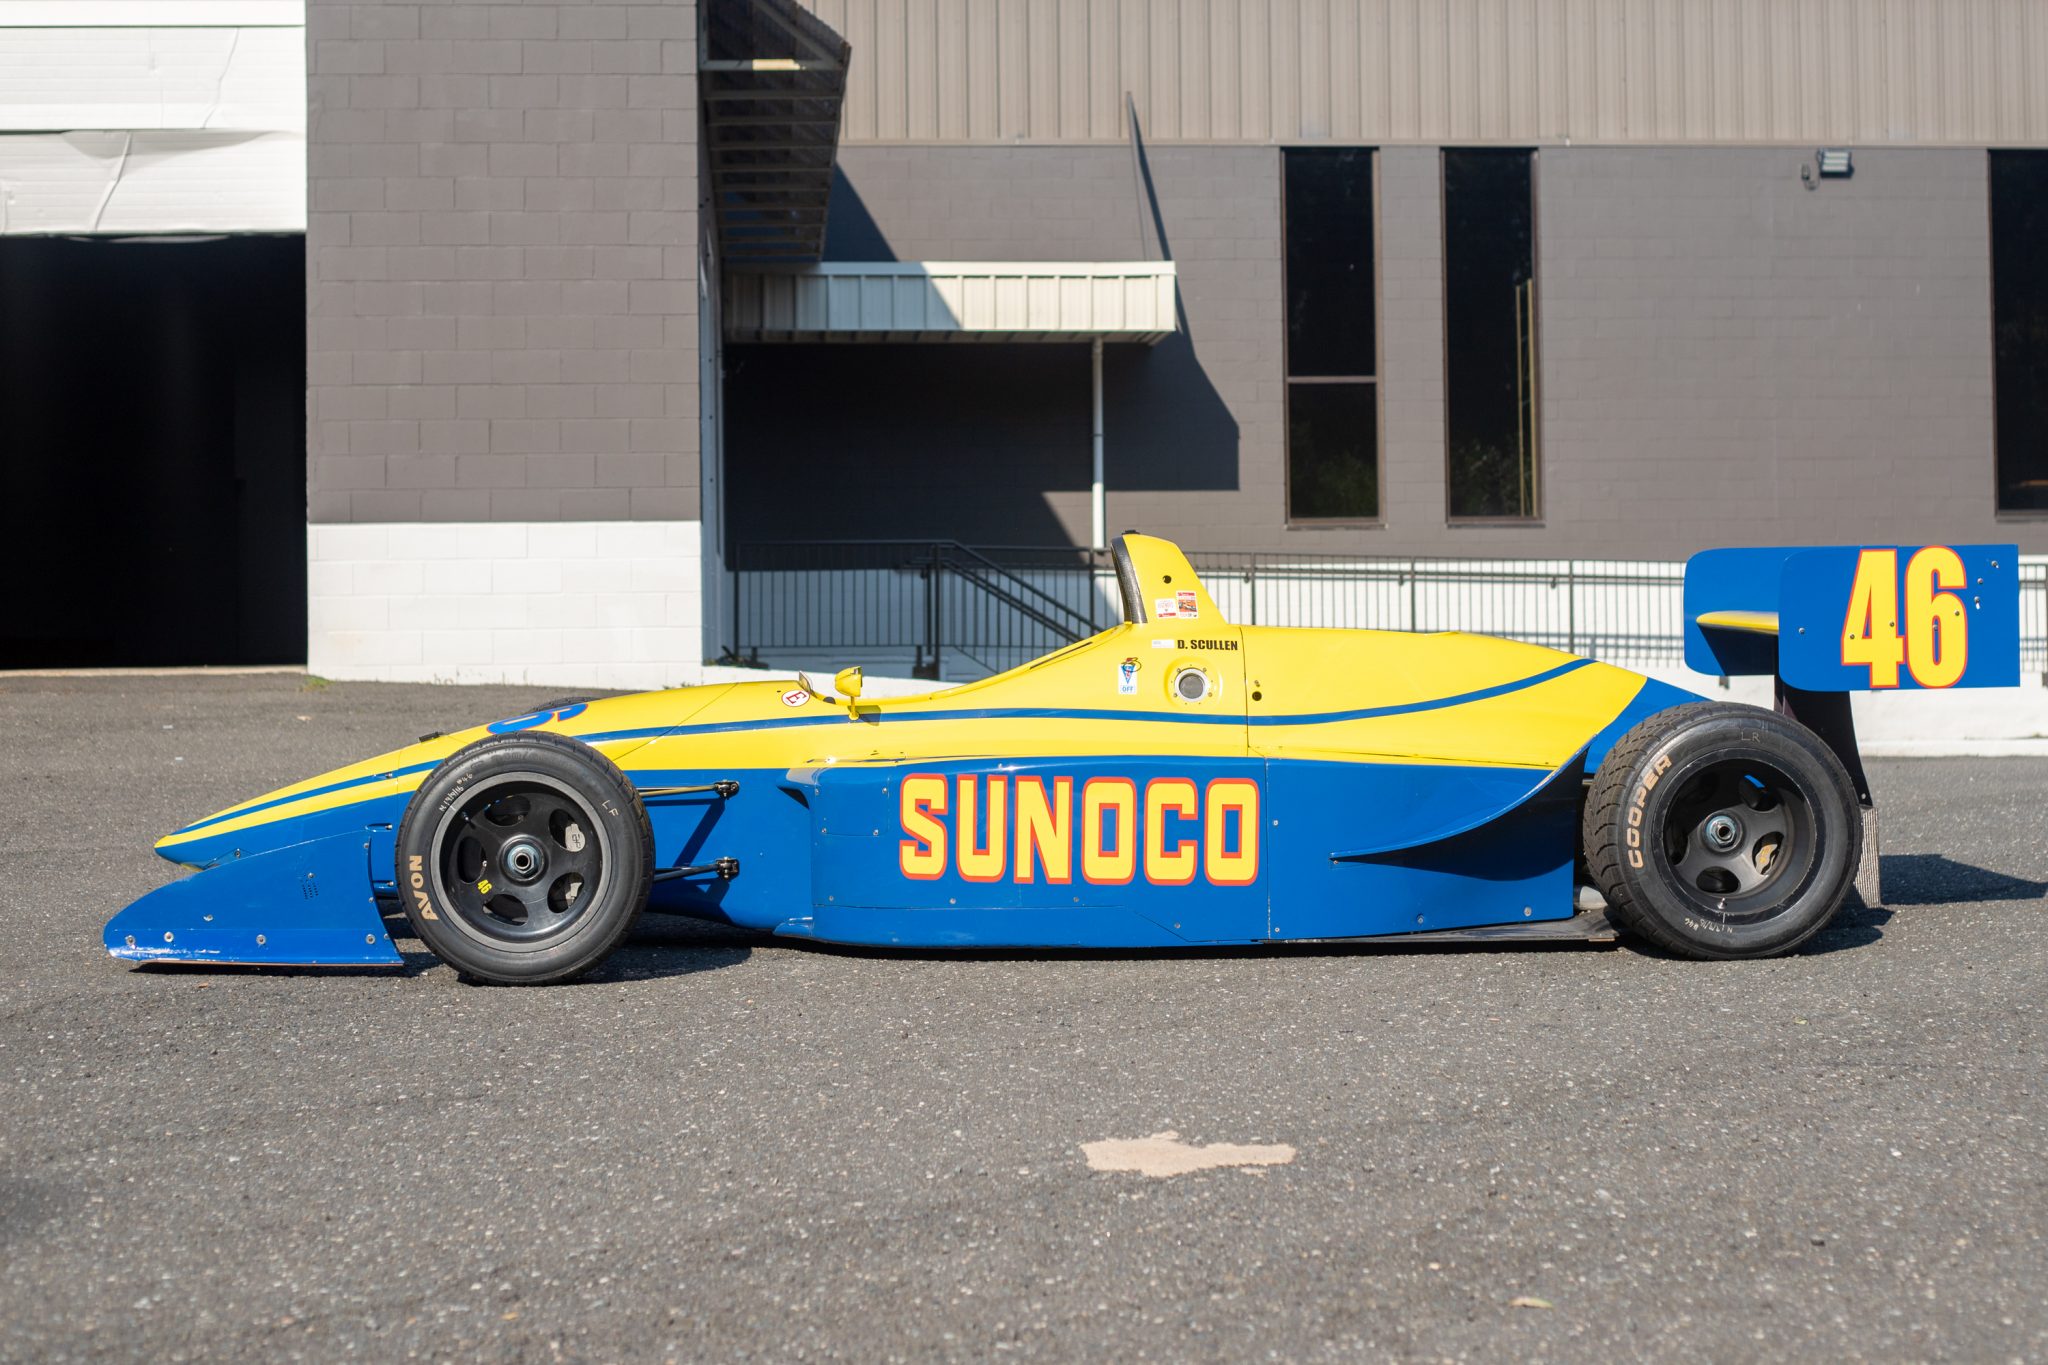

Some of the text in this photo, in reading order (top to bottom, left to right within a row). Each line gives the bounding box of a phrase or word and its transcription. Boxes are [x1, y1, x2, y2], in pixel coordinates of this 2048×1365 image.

[1177, 639, 1238, 651] D. SCULLEN
[1841, 545, 1969, 689] 46
[899, 772, 1260, 886] SUNOCO
[1626, 754, 1673, 869] COOPER
[409, 855, 438, 921] AVON
[477, 879, 493, 895] 46
